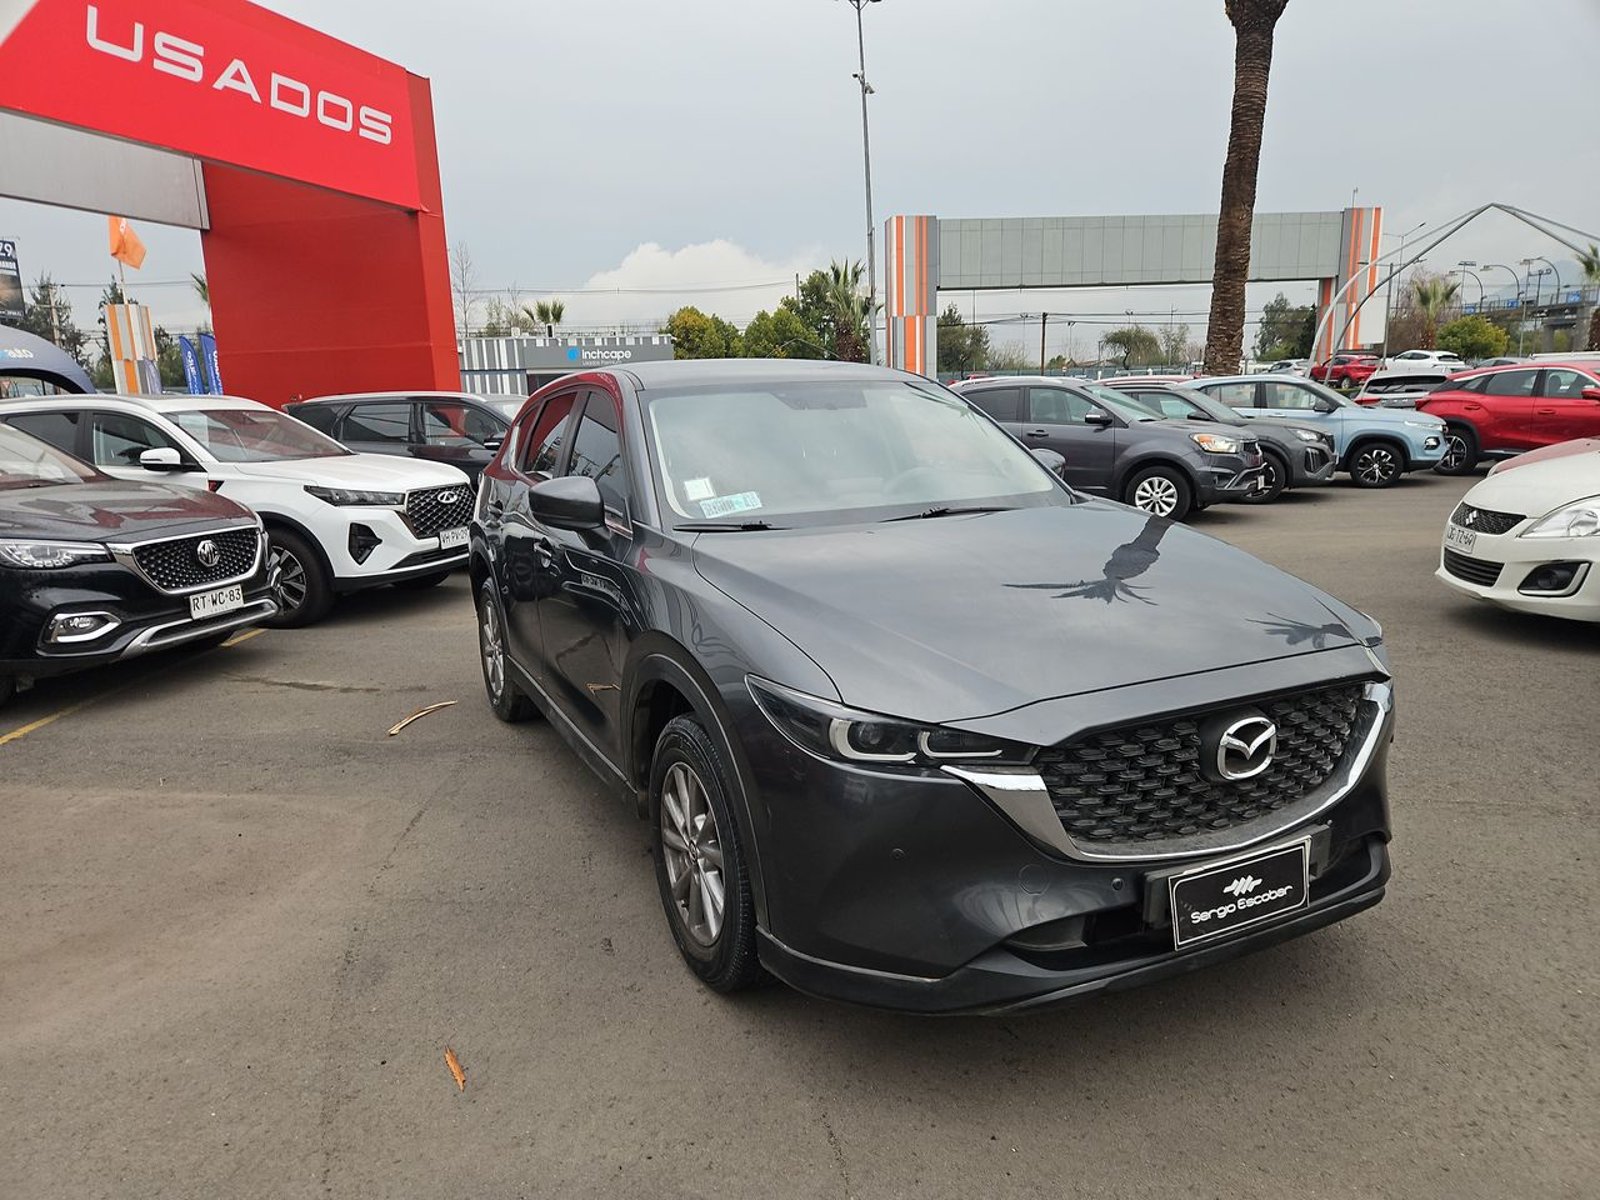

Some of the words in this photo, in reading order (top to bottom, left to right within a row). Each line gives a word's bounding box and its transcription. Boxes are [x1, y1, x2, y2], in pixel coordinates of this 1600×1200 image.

[86, 3, 393, 145] USADOS
[582, 348, 632, 361] Inchcape
[1237, 885, 1293, 910] Escobar
